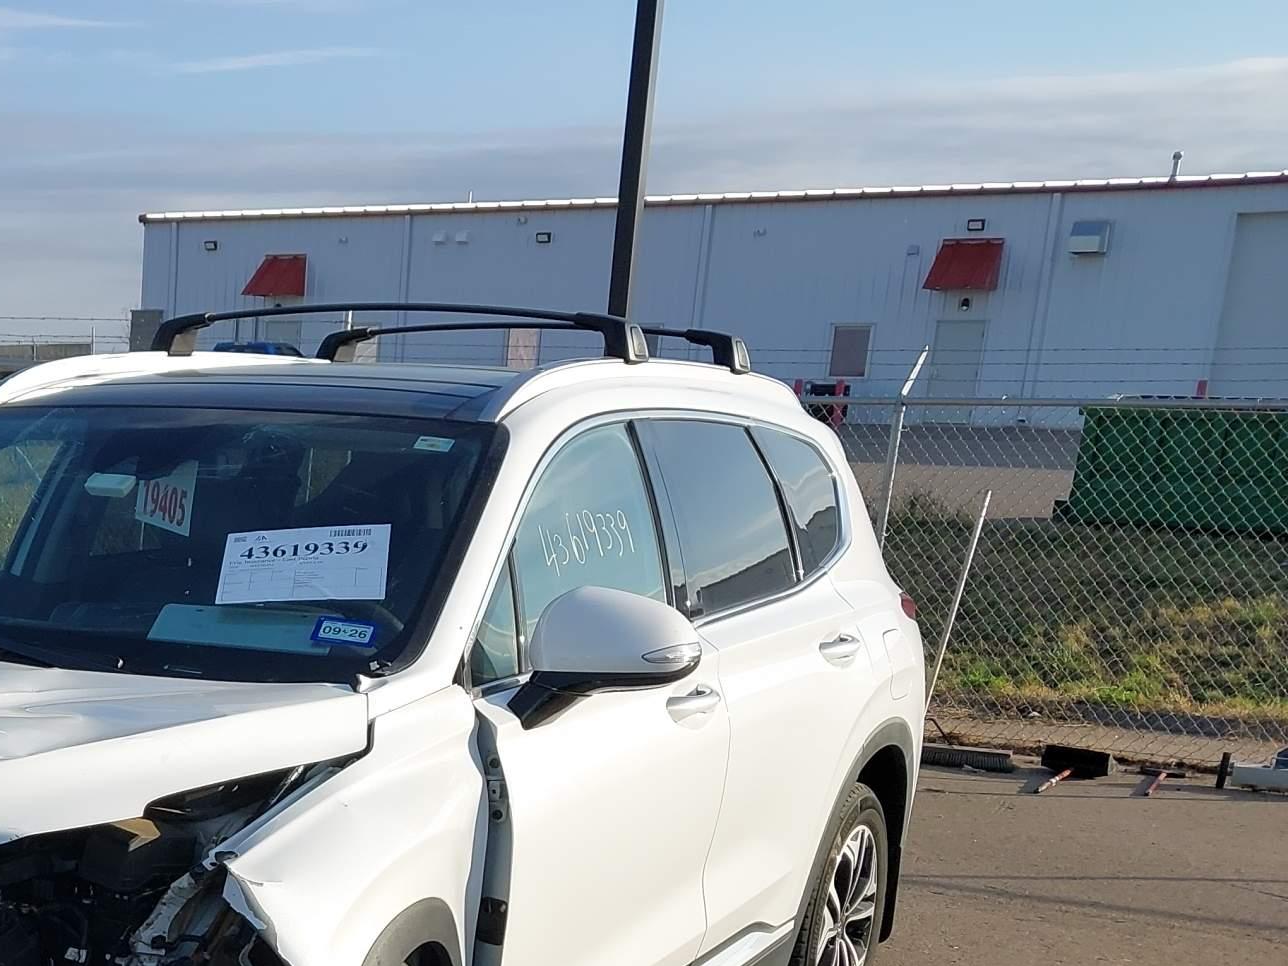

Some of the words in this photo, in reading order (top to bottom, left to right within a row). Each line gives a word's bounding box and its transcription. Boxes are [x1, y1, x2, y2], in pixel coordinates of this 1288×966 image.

[143, 480, 188, 527] 19405
[240, 540, 368, 559] 43619339
[538, 509, 635, 577] 43619339
